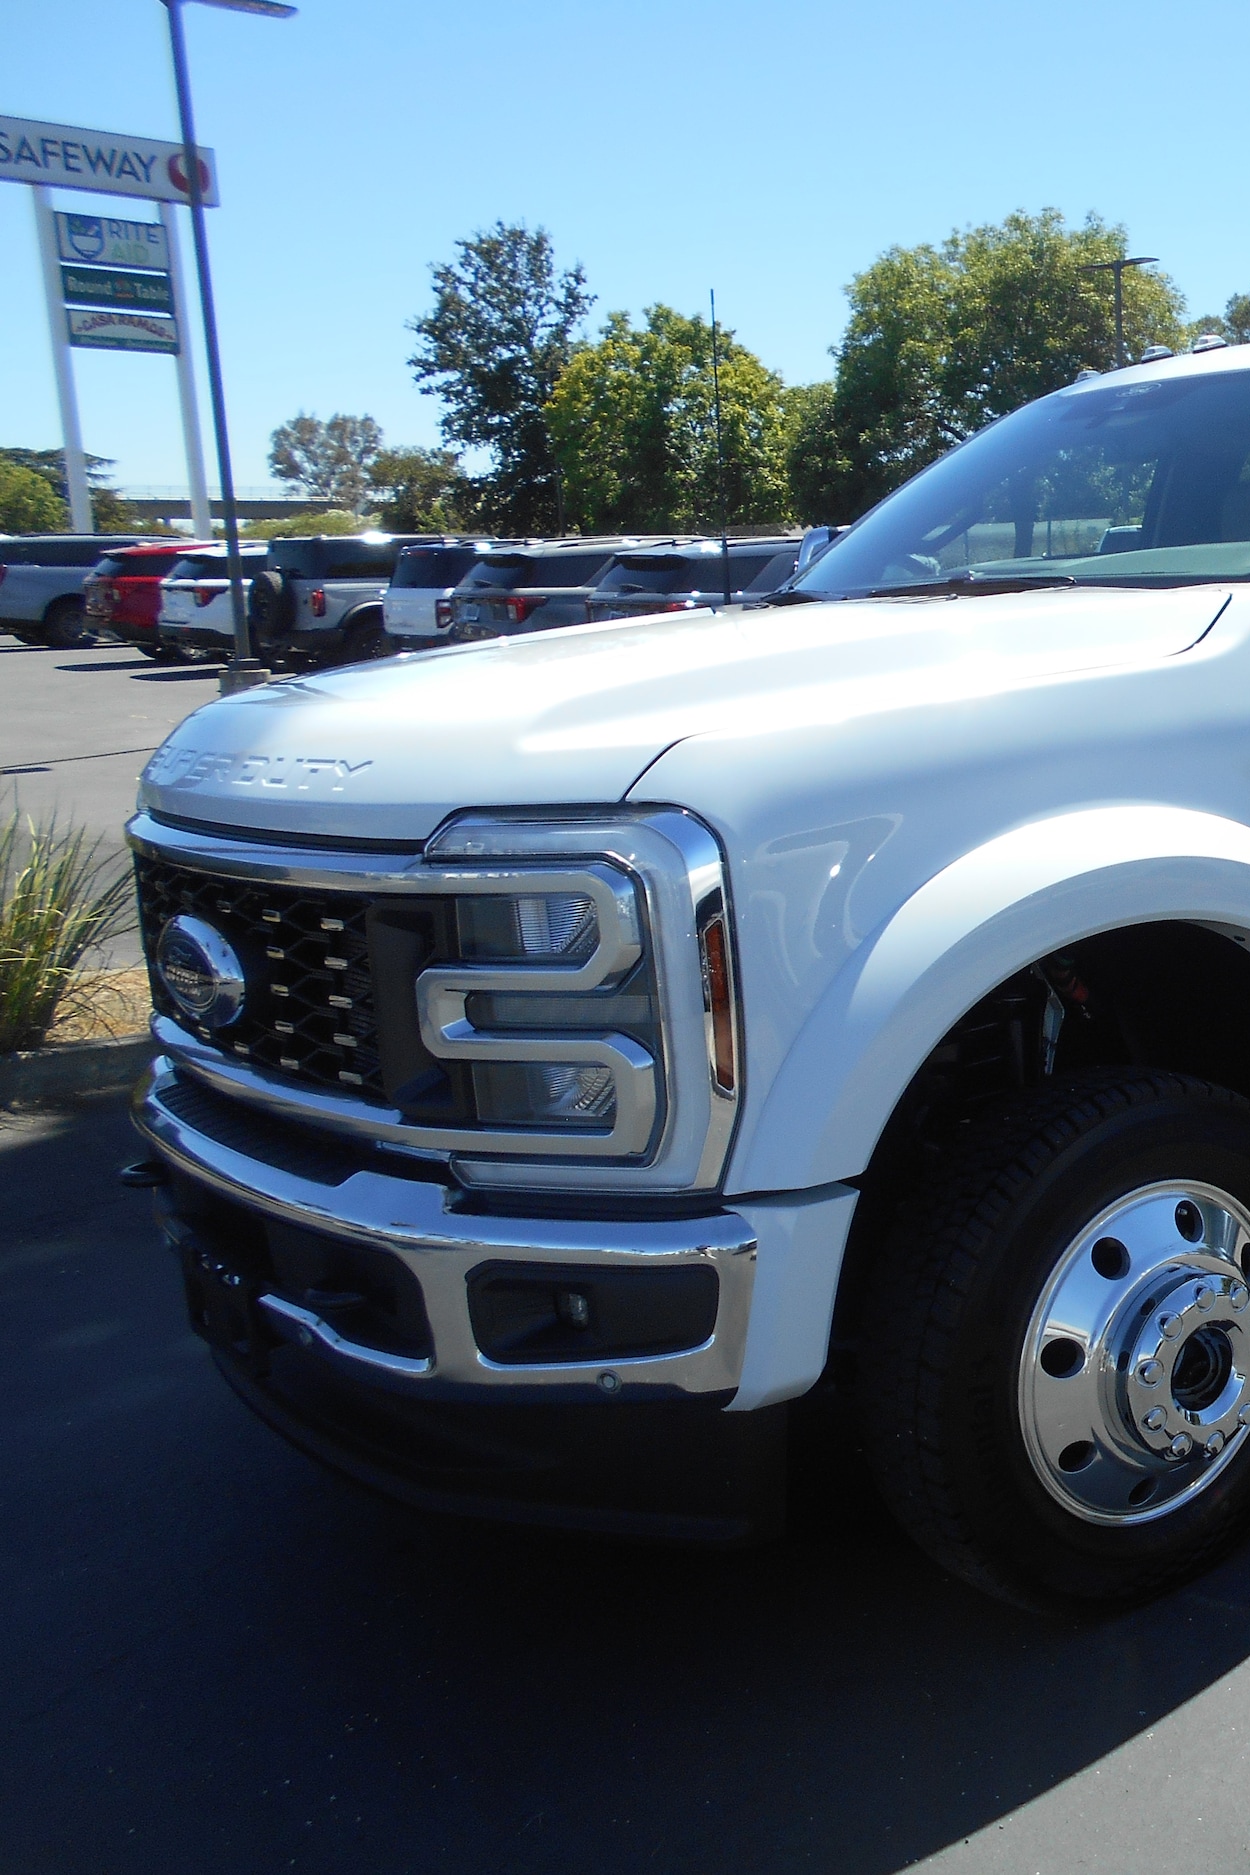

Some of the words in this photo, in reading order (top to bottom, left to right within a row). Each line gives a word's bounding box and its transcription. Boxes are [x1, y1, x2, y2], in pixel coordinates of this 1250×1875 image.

[0, 130, 157, 183] SAFEWAY
[107, 219, 160, 244] RITE
[111, 241, 149, 263] AID
